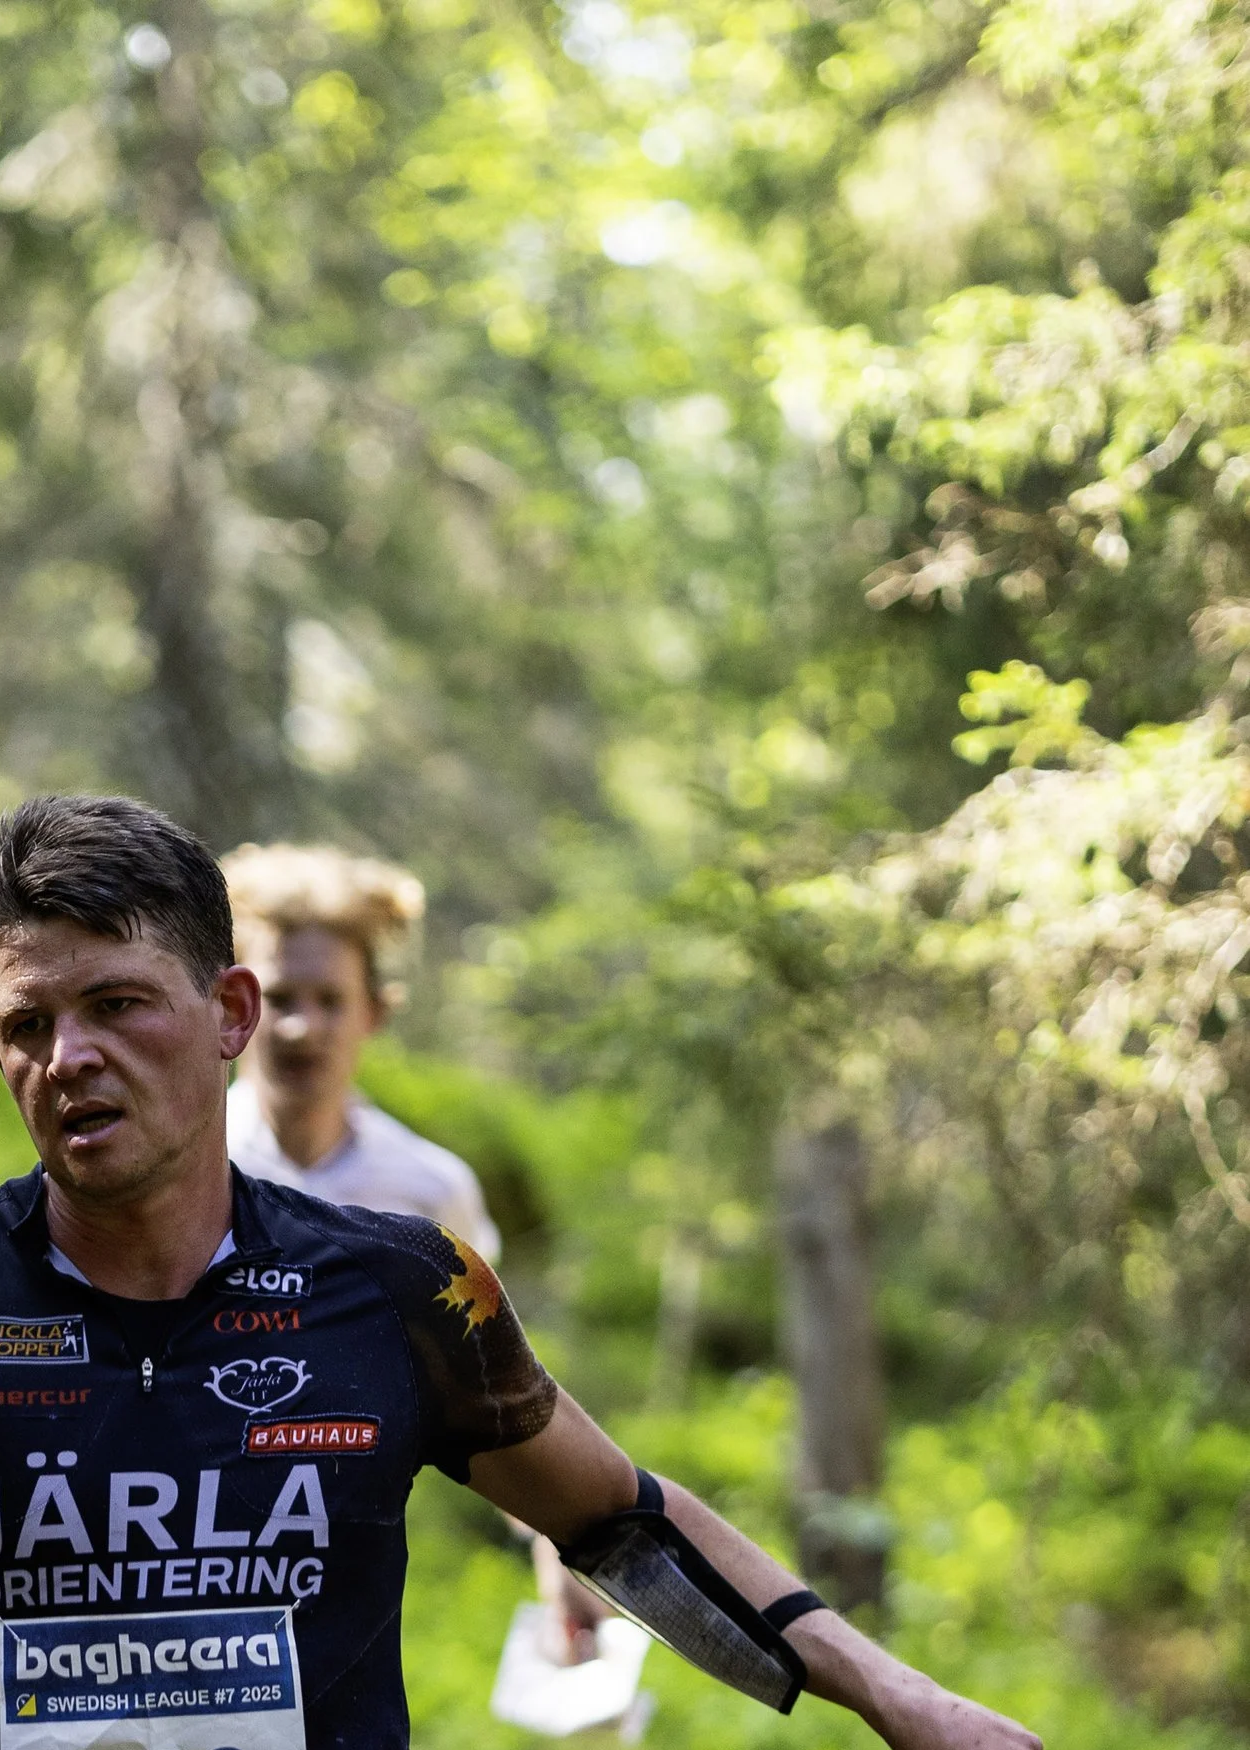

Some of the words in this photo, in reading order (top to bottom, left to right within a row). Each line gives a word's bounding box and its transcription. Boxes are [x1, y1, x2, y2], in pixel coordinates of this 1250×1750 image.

[213, 1307, 303, 1333] COWI
[254, 1427, 374, 1446] BAUHAUS
[16, 1633, 282, 1685] bagheera
[46, 1693, 129, 1714] SWEDISH
[134, 1689, 210, 1709] LEAGUE
[214, 1688, 235, 1705] #7
[241, 1684, 282, 1703] 2025
